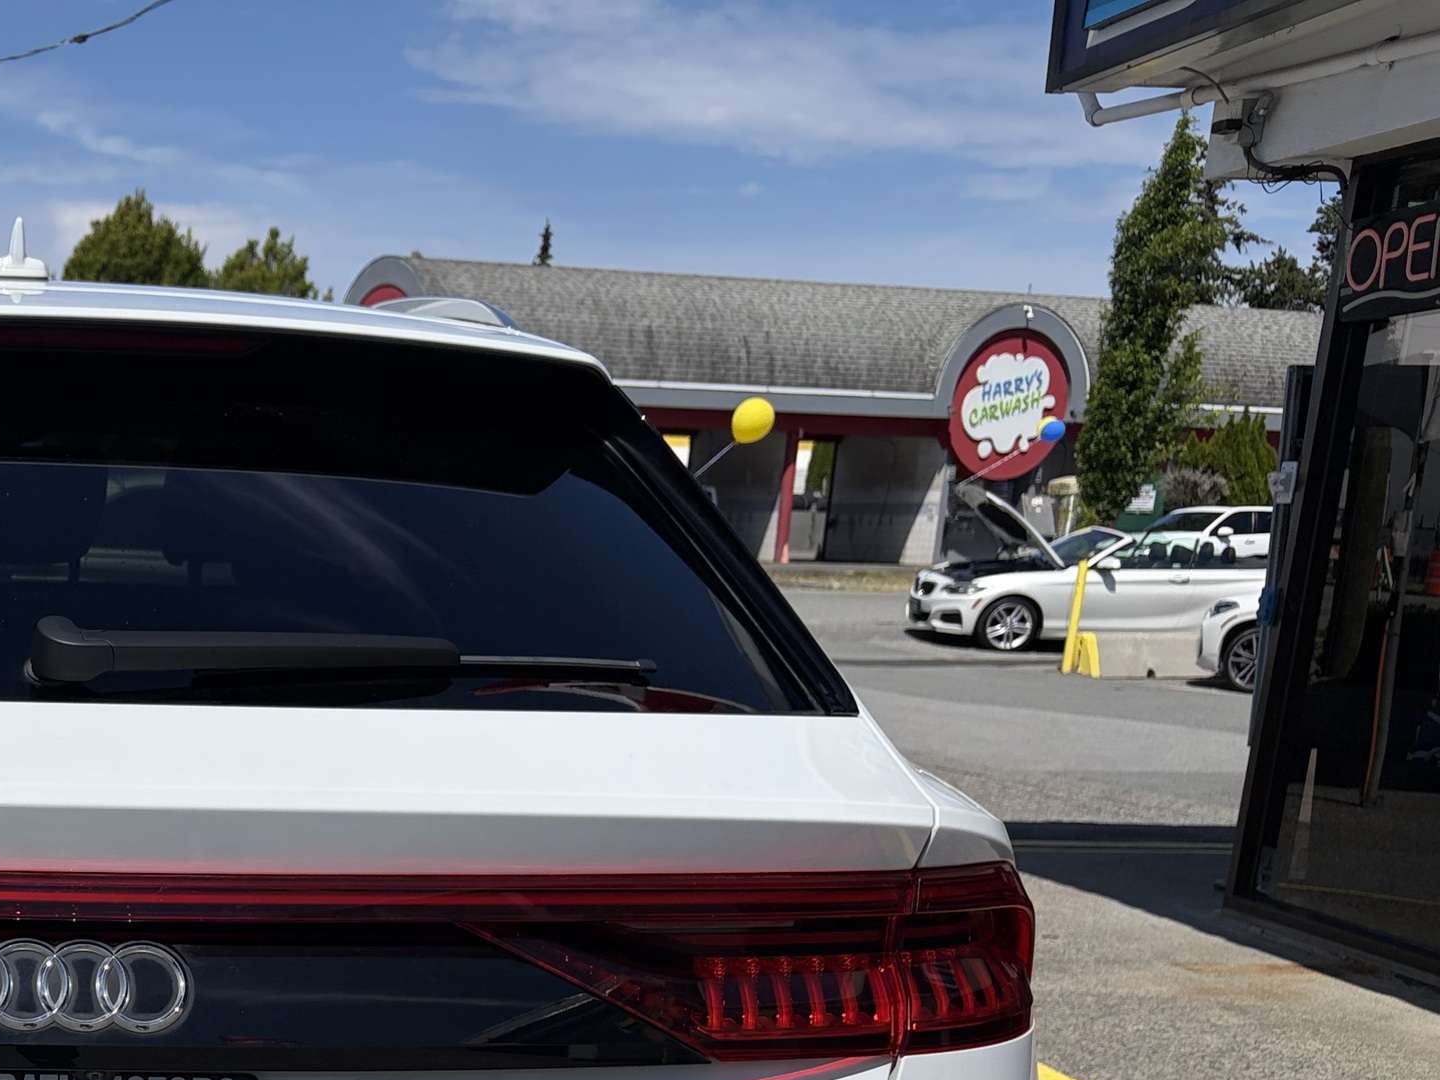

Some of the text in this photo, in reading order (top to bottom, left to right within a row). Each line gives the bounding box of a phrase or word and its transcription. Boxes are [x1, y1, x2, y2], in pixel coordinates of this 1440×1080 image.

[1346, 214, 1440, 292] OPE
[982, 370, 1043, 402] HARRY'S
[969, 390, 1041, 428] CARWASH
